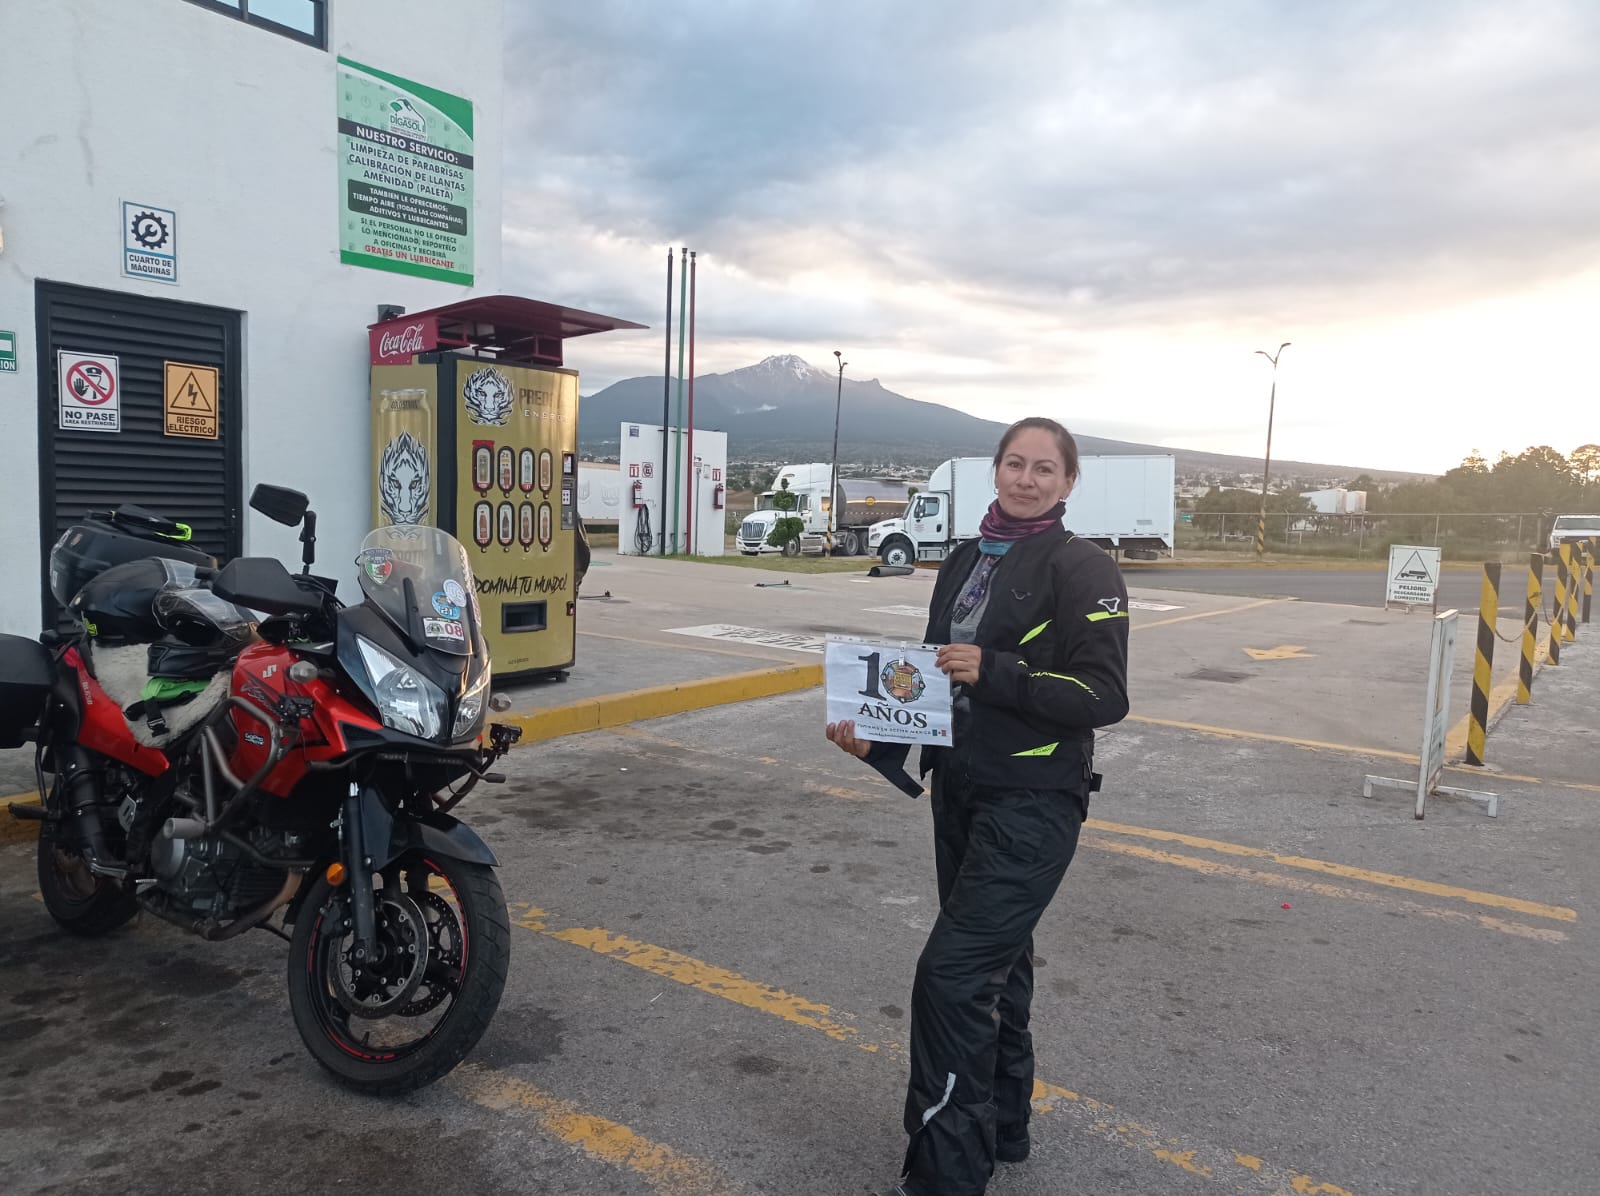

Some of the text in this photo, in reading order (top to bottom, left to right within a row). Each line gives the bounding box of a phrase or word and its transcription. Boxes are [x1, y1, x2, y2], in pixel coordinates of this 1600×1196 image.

[356, 126, 406, 149] NUESTRO
[410, 142, 458, 164] SERVICIO:
[351, 142, 463, 180] LIMPIEZA DE PARABRISAS
[363, 170, 454, 201] AMENIDAD (PALETA)
[415, 171, 426, 181] DE
[429, 174, 465, 191] LLANTAS
[353, 192, 378, 203] TIEMPO
[380, 200, 395, 208] AIRE
[396, 203, 417, 213] (TODAS
[418, 208, 428, 216] LAS
[409, 197, 448, 212] OFRECEMOS:
[369, 206, 400, 218] ADITIVOS
[408, 214, 449, 229] LUBRICANTES
[360, 217, 367, 225] SI
[378, 221, 412, 235] PERSONAL
[414, 229, 425, 237] NO
[426, 231, 433, 239] LE
[434, 233, 457, 244] OFRECE
[361, 226, 371, 234] LO
[372, 229, 421, 245] MENCIONADO,
[364, 244, 455, 268] GRATIS UN LUBRICANTE
[380, 240, 411, 252] OFICINAS
[129, 254, 160, 265] CUARTO
[130, 263, 171, 276] MÁQUINAS
[379, 323, 424, 358] Coca-Cola
[65, 411, 116, 421] NO PASE
[176, 416, 206, 426] RIESGO
[169, 424, 213, 434] ELECTRICO
[518, 576, 533, 596] TU
[534, 573, 568, 594] MUNDO!
[445, 623, 463, 638] 08
[857, 702, 928, 729] AÑOS
